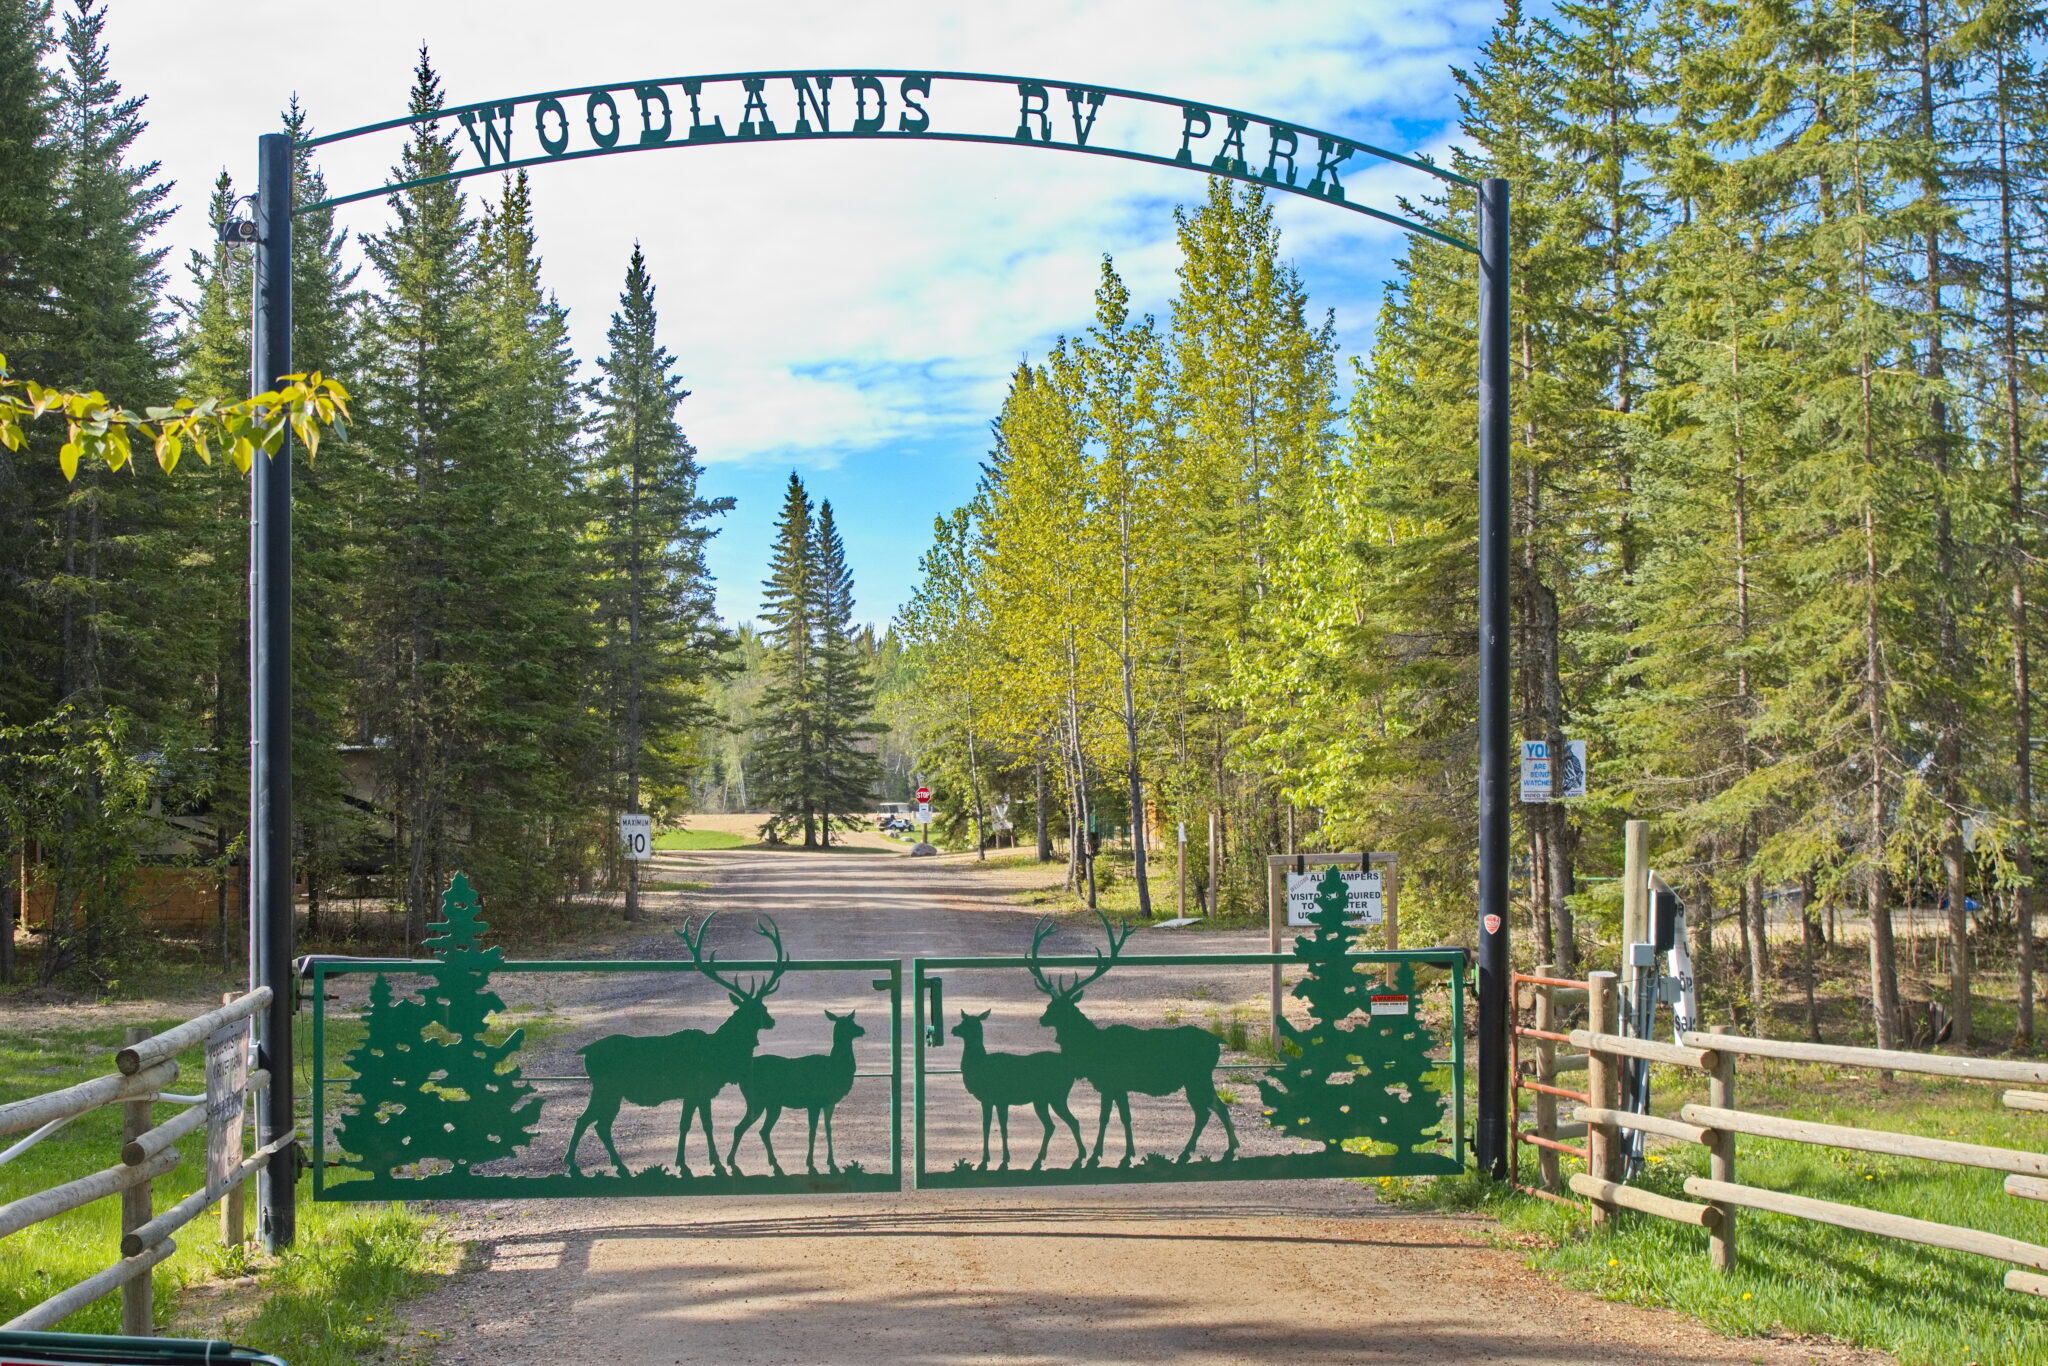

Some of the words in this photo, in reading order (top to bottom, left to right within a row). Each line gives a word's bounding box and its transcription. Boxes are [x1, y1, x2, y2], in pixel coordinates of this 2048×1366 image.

[457, 75, 932, 167] WOODLANDS
[1015, 83, 1106, 146] RV
[1174, 106, 1356, 200] PARK
[916, 791, 930, 799] STOP
[627, 833, 645, 852] 10
[1290, 893, 1332, 901] VISITOS
[1347, 891, 1381, 899] QUIRED
[1301, 902, 1315, 910] TO
